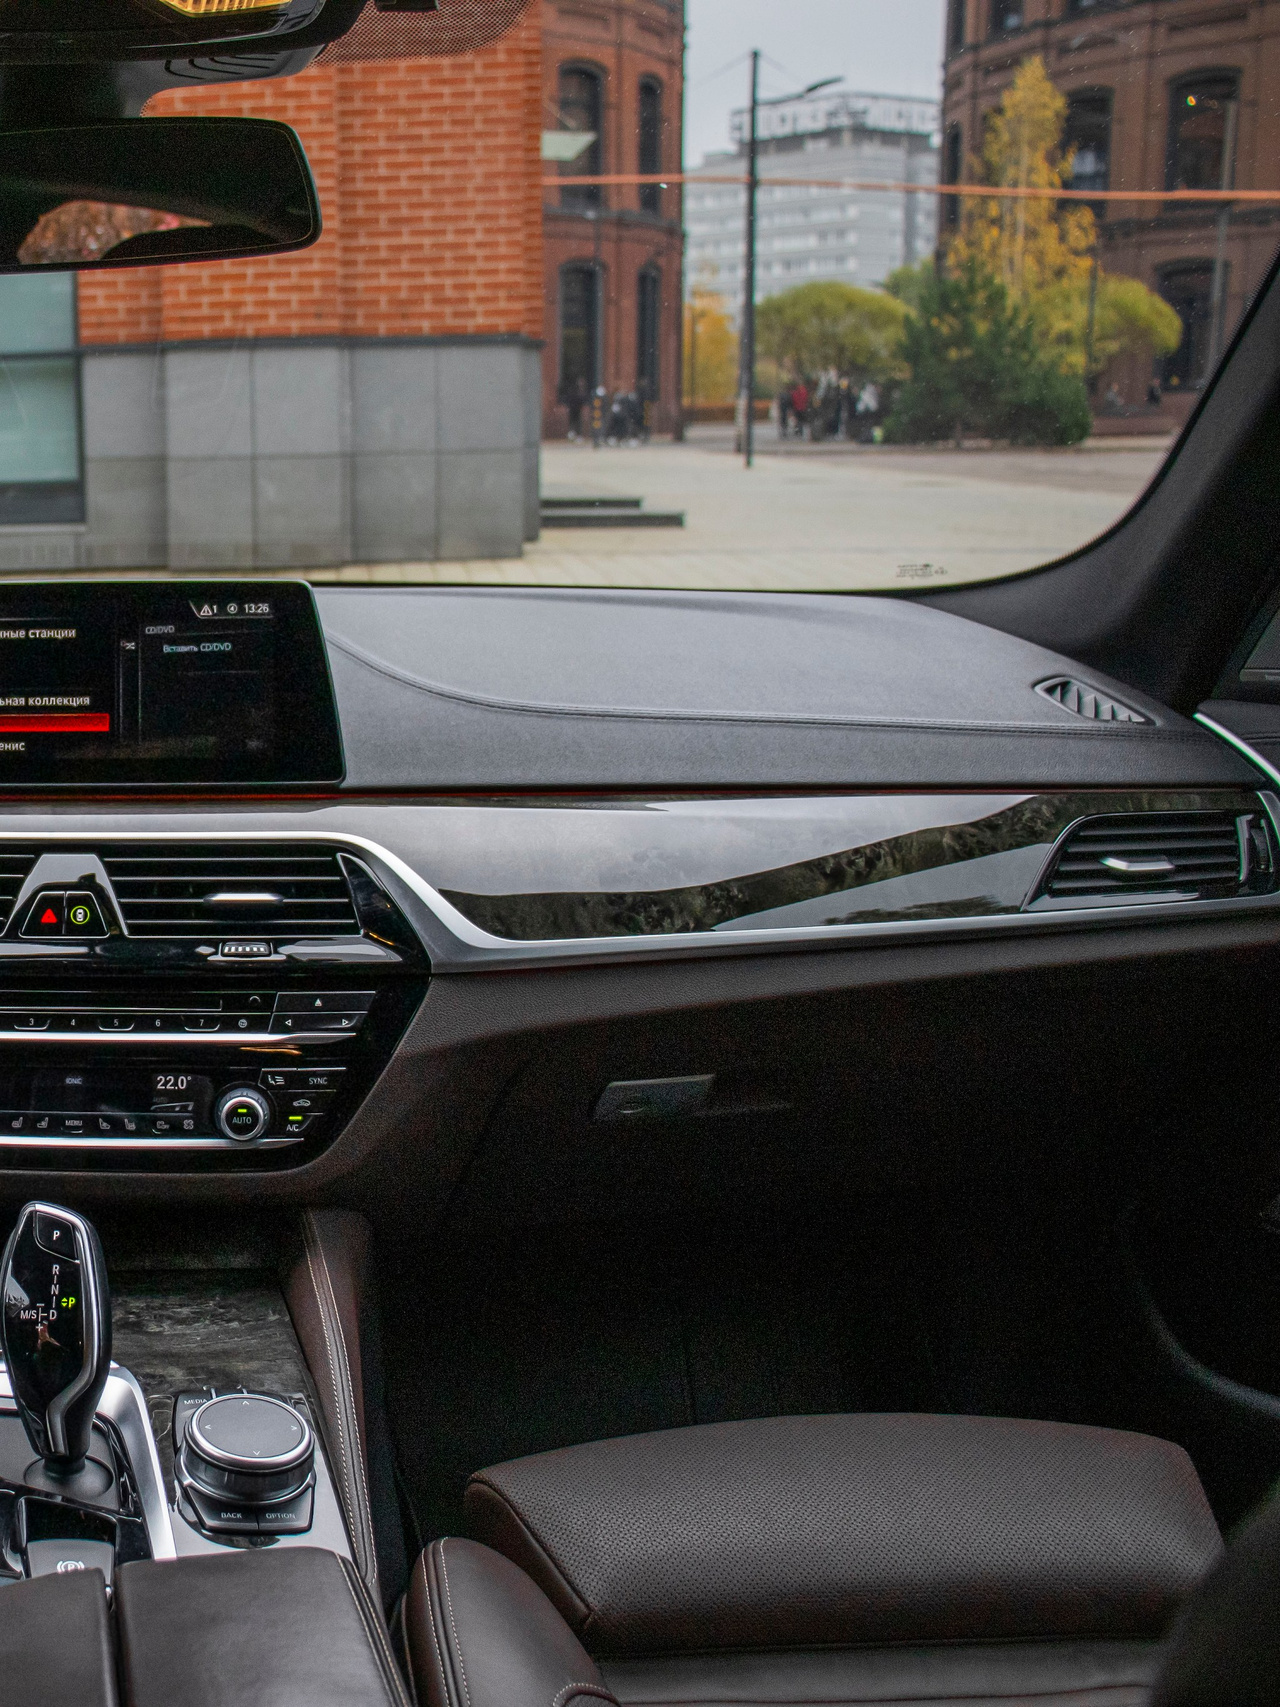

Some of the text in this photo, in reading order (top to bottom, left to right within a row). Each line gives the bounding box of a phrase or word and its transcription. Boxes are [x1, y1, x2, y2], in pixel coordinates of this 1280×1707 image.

[244, 604, 270, 614] 13:26
[28, 629, 76, 640] станции
[200, 642, 232, 652] CD/DVD
[28, 696, 90, 707] коллекция
[156, 1076, 192, 1090] 22.0°
[286, 1124, 299, 1132] A/C
[53, 1230, 60, 1240] P
[52, 1264, 59, 1274] R
[51, 1284, 59, 1294] N
[69, 1297, 76, 1308] P
[20, 1310, 37, 1320] M/S
[49, 1310, 57, 1320] D
